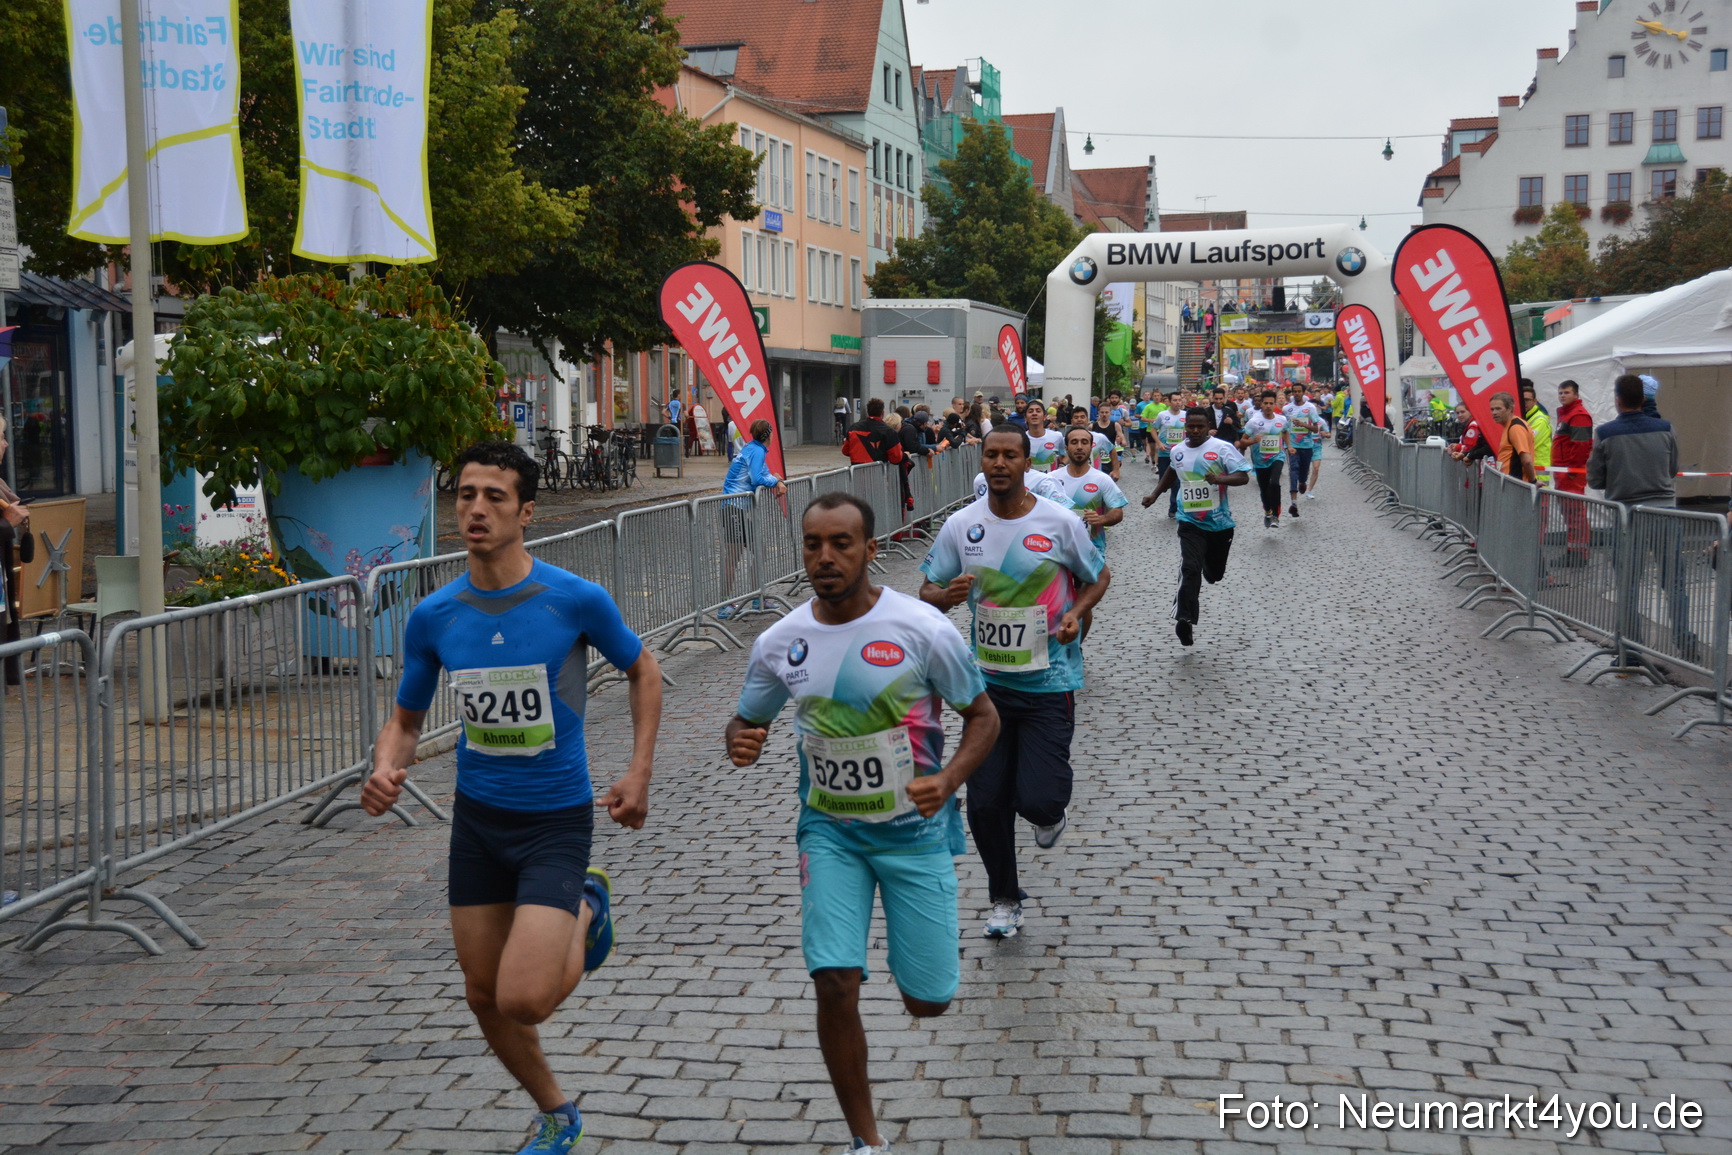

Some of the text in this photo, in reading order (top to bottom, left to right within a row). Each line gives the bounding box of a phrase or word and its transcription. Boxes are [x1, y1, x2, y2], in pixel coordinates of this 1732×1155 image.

[300, 41, 395, 72] Wir sind
[1107, 238, 1326, 266] BMW Laufsport
[1265, 335, 1292, 345] ZIEL
[516, 407, 524, 419] P
[1261, 439, 1278, 447] 5237
[1183, 487, 1210, 500] 5199
[978, 620, 1026, 648] 5207
[867, 646, 900, 660] Hervis
[984, 650, 1016, 663] Yeshitla
[489, 669, 538, 682] BOCK
[786, 668, 809, 680] PARTL
[464, 689, 542, 723] 5249
[483, 732, 525, 745] Ahmad
[830, 738, 878, 751] BOCK
[812, 756, 884, 791] 5239
[817, 793, 885, 811] Mohammad
